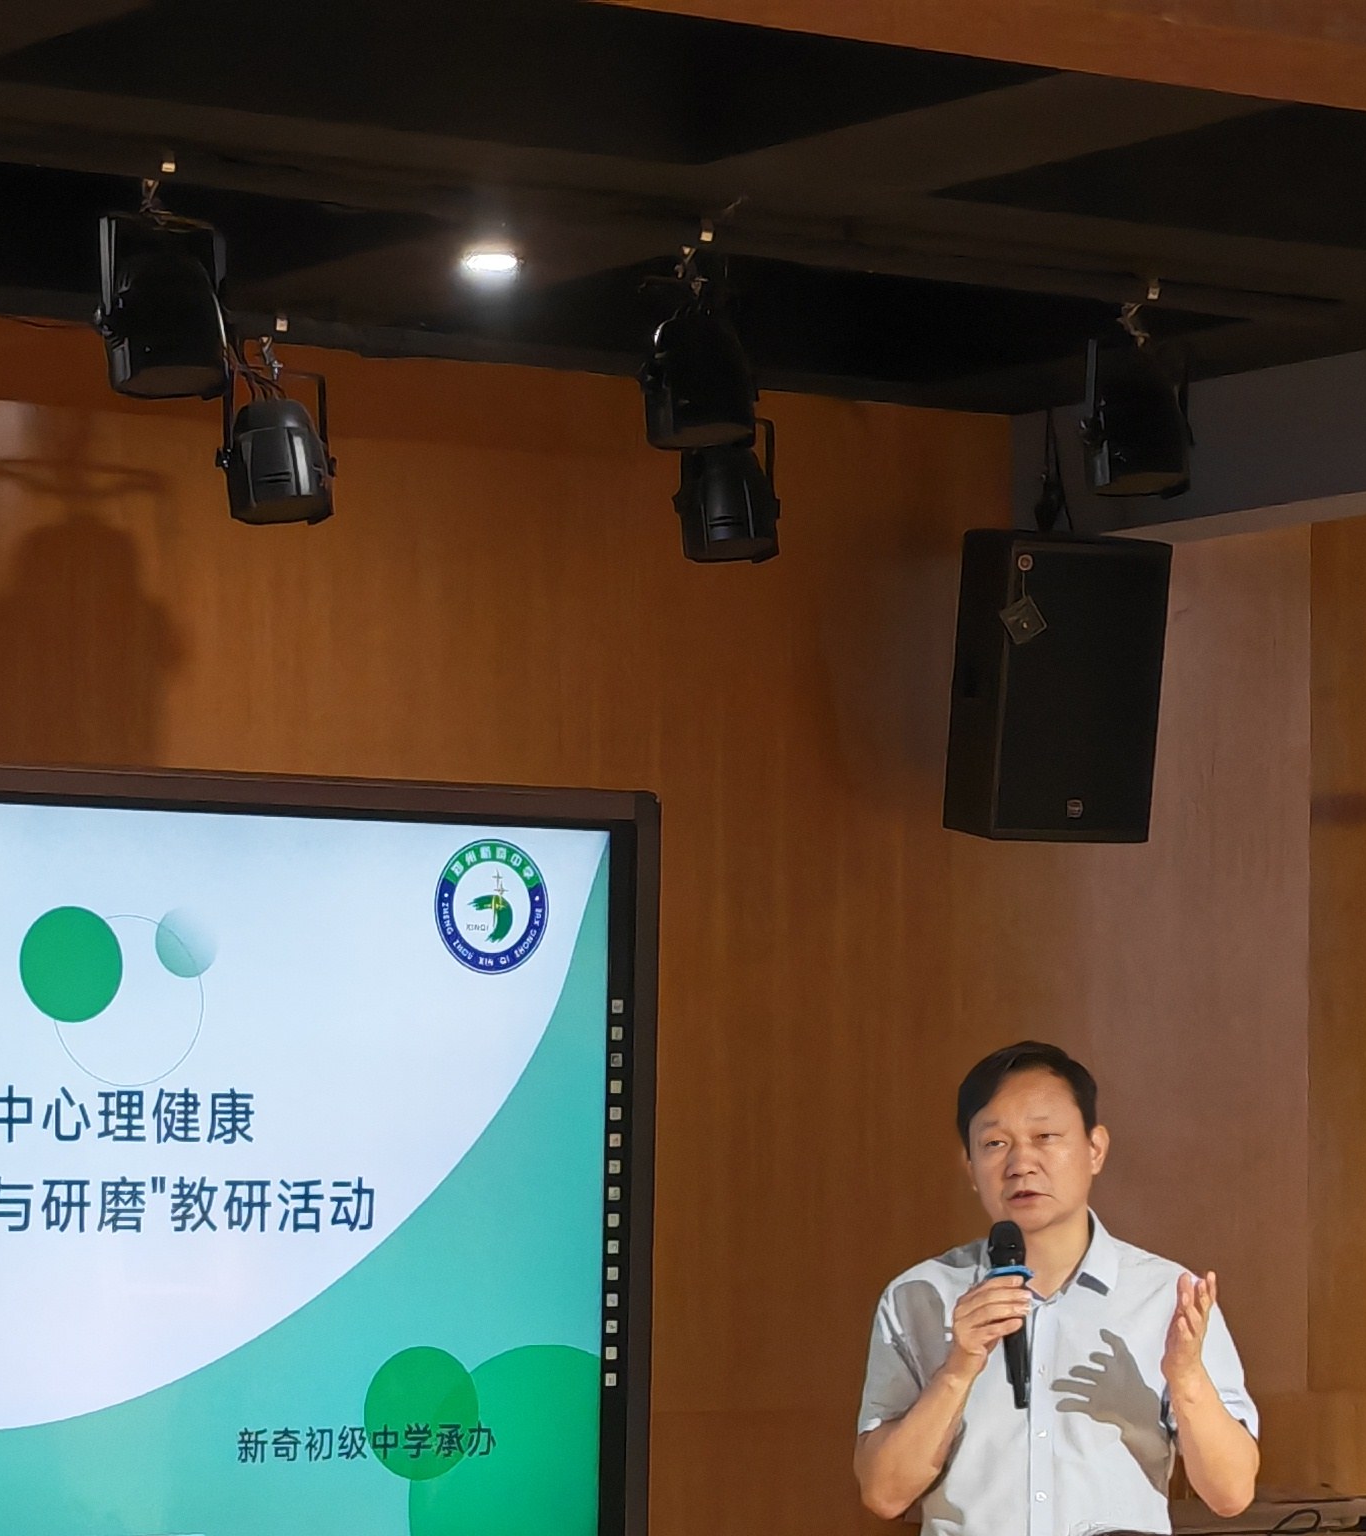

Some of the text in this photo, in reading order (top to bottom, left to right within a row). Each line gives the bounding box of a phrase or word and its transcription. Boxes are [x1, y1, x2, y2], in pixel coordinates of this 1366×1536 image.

[237, 1422, 497, 1464] 新奇初级中学承办
